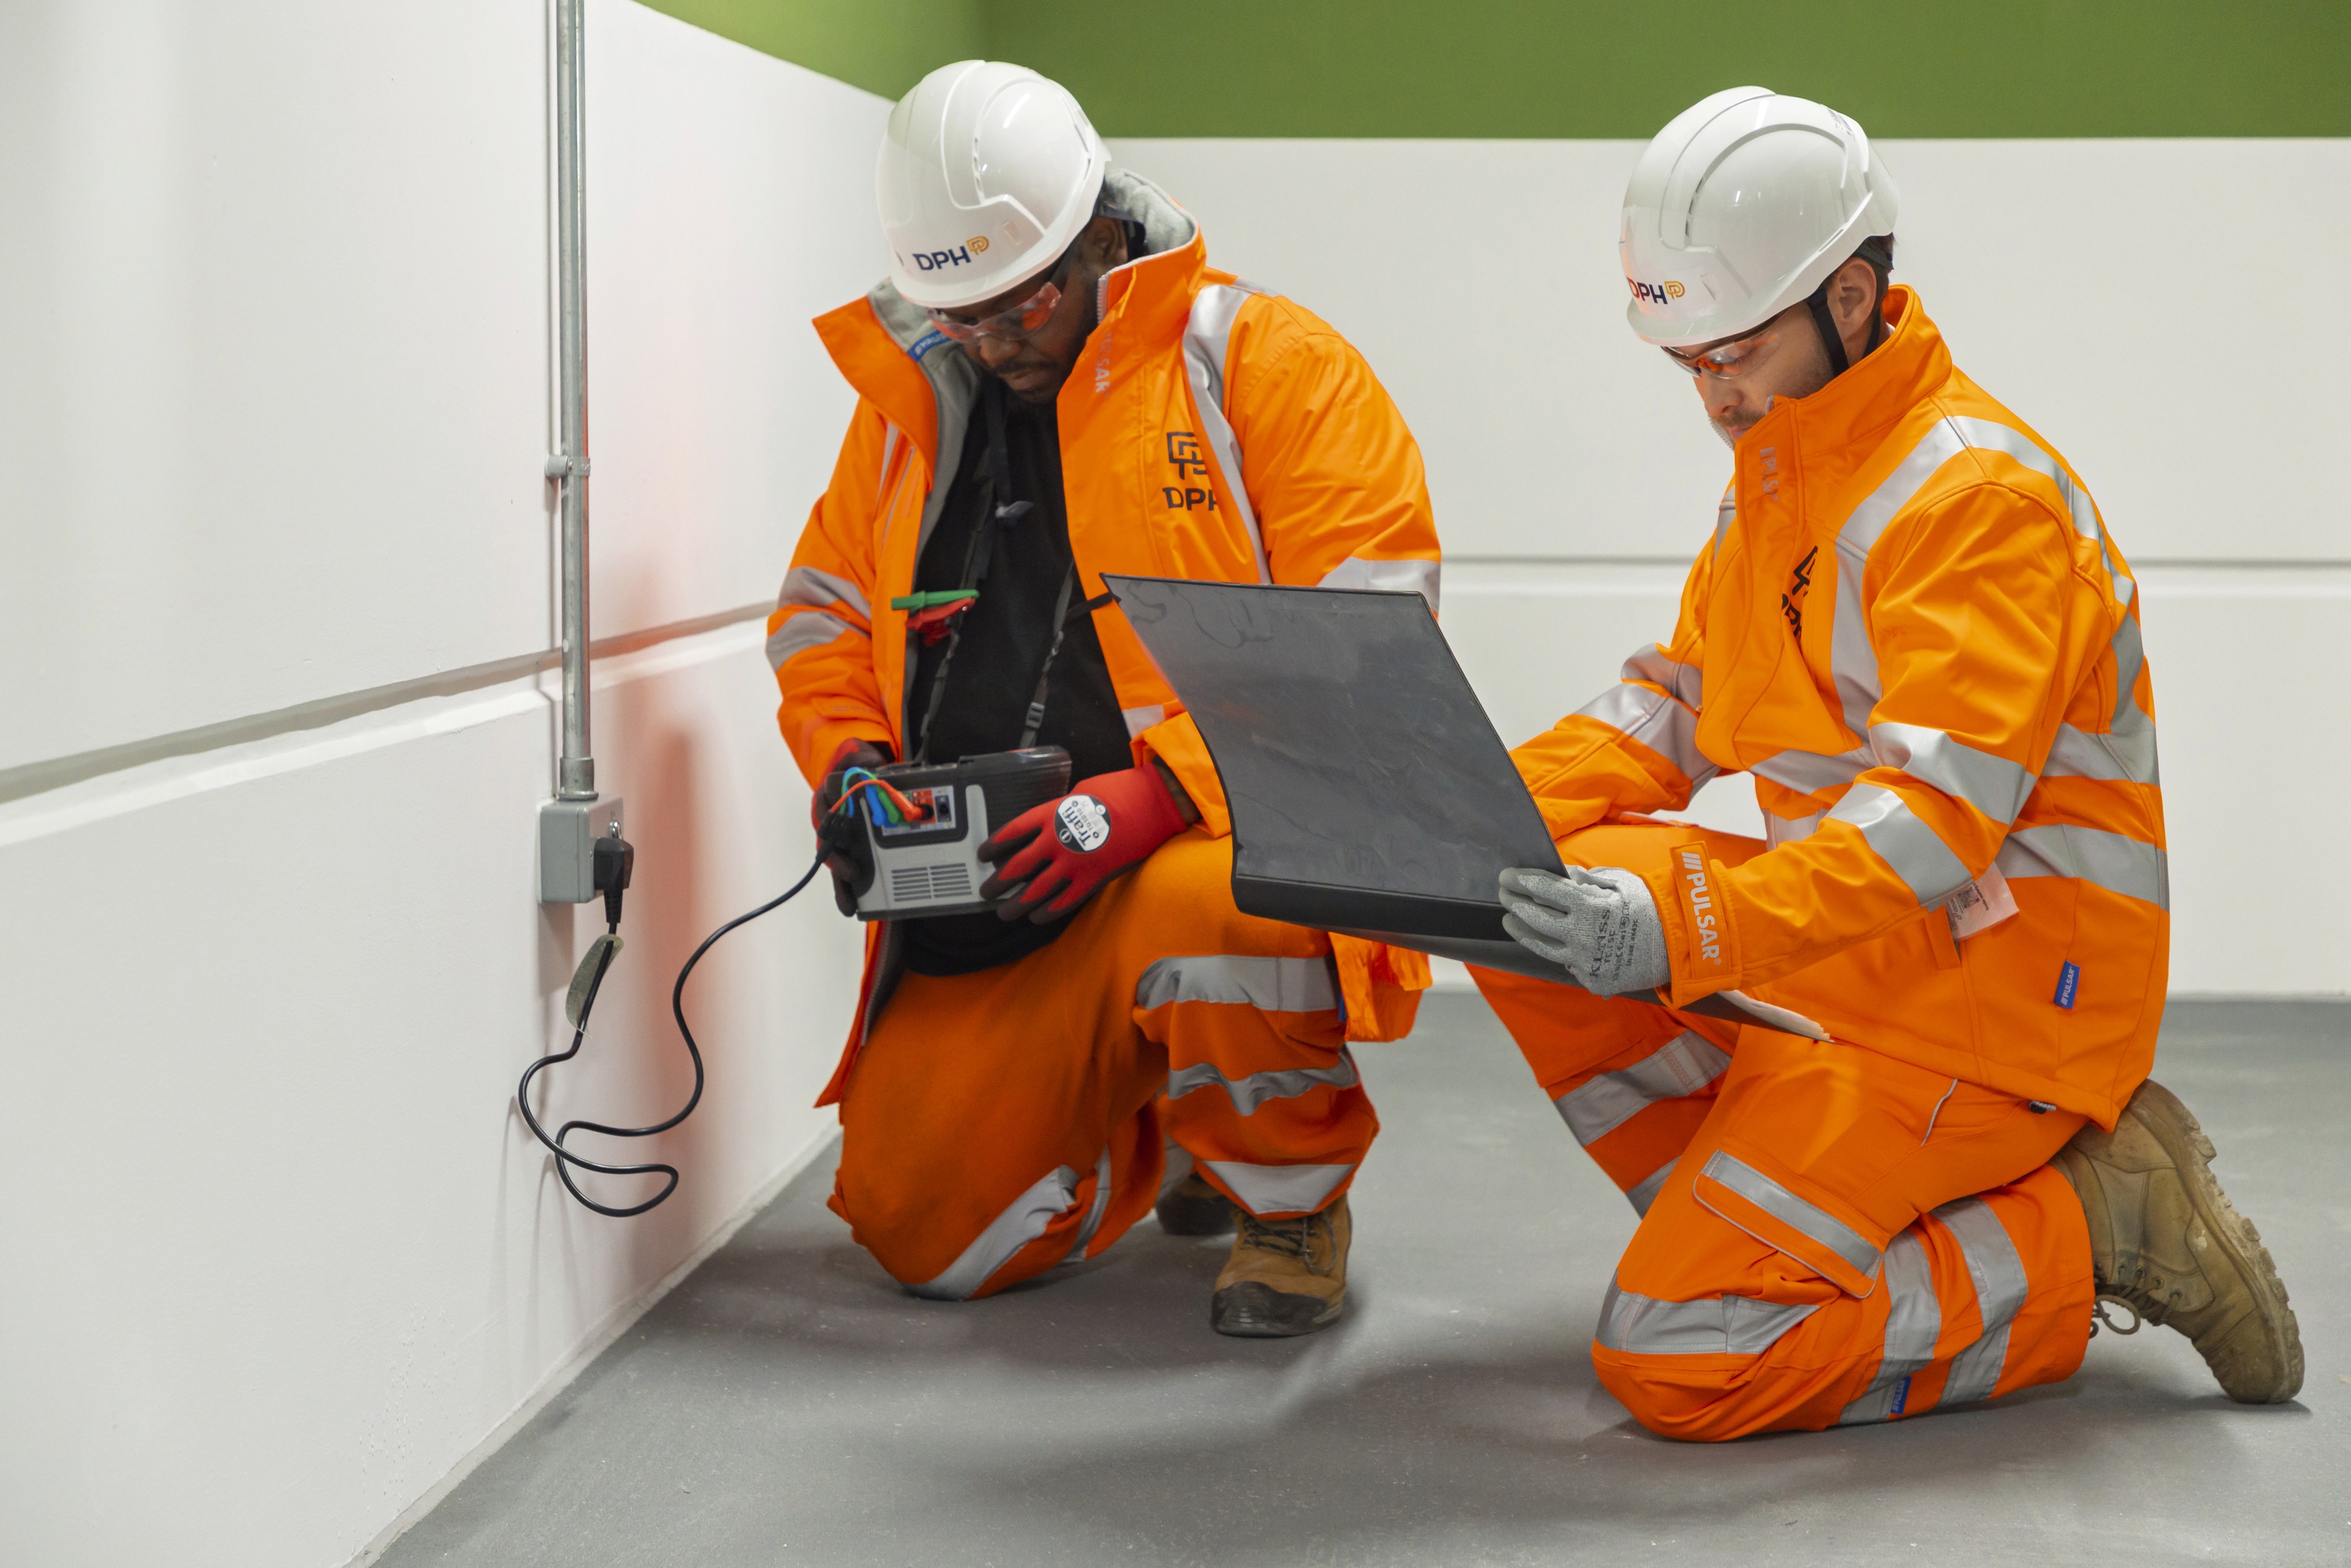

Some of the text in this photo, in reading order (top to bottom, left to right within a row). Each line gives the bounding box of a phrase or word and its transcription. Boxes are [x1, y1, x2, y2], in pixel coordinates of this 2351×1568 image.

[912, 246, 972, 270] DPH
[1062, 807, 1091, 846] Traffi
[1686, 872, 1719, 961] PULSAR
[2063, 968, 2075, 998] PULSAR
